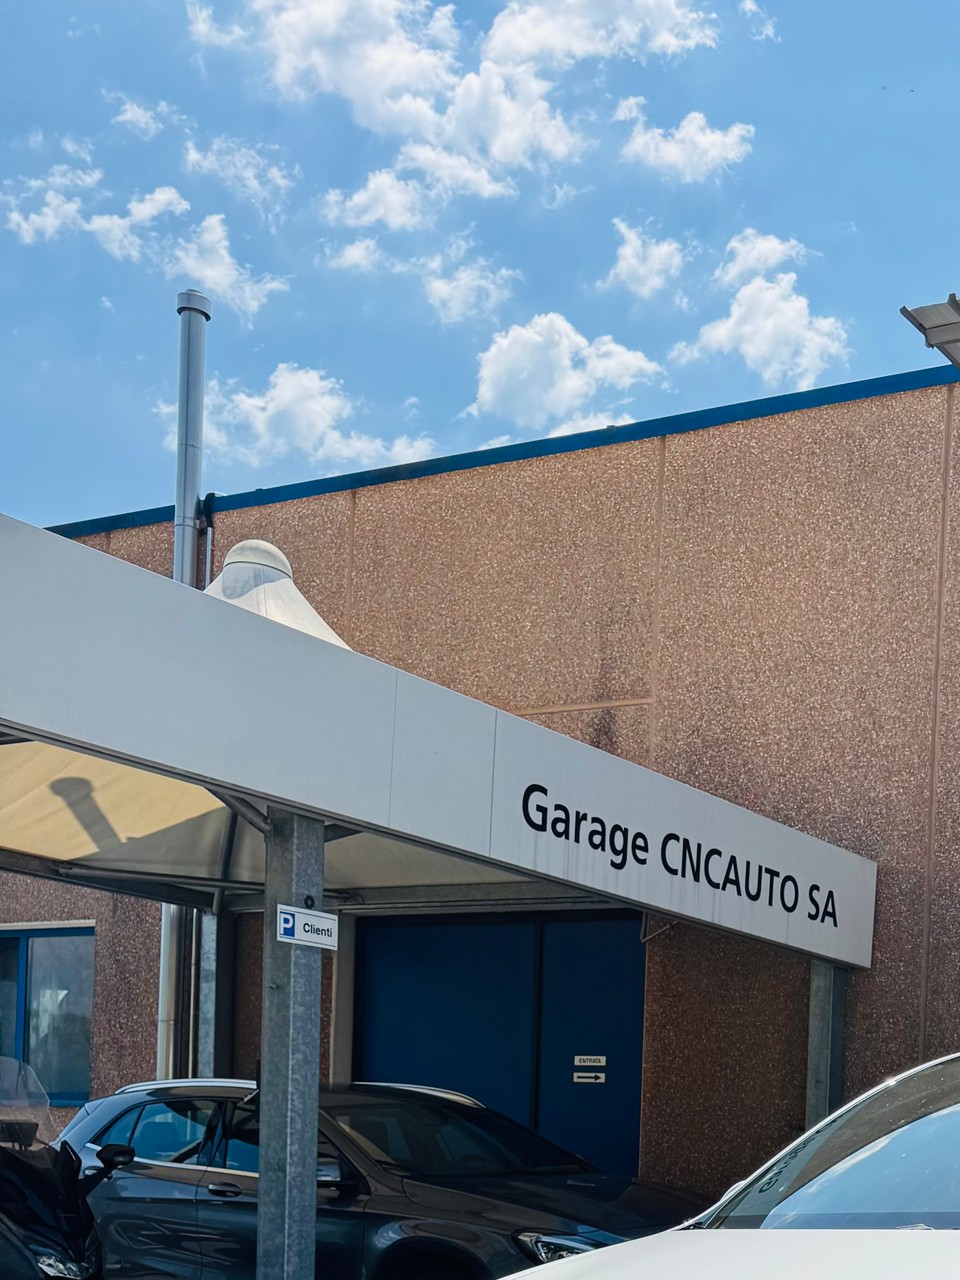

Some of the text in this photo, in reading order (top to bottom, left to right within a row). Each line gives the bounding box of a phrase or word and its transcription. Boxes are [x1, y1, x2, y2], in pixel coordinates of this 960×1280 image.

[521, 783, 839, 928] Garage CNCAUTO SA
[280, 913, 333, 938] P Clienti
